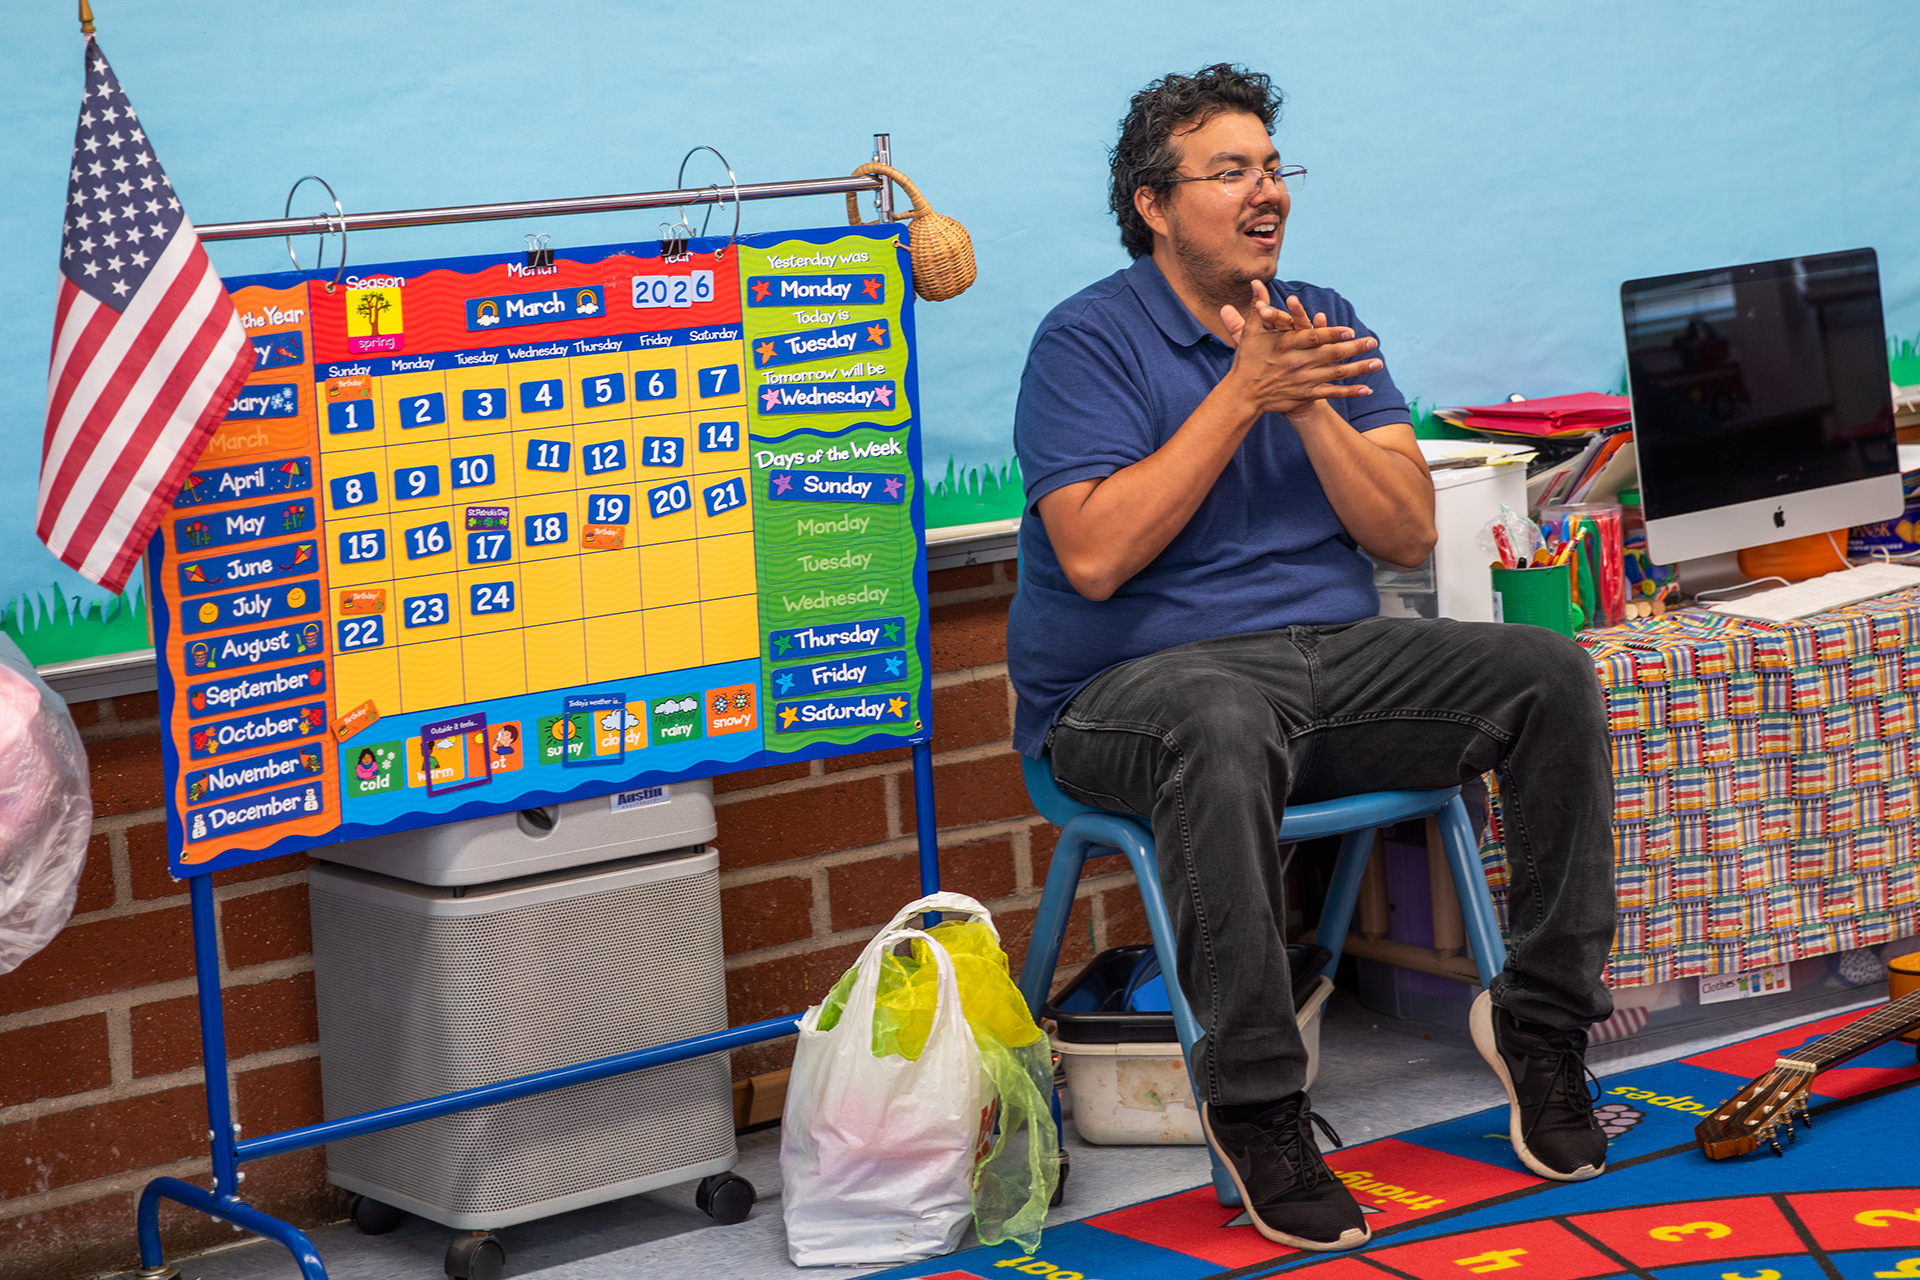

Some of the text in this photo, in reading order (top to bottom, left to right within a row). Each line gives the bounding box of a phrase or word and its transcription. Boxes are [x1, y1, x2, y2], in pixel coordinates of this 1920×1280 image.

[767, 252, 869, 269] Yesterday was
[346, 275, 406, 290] Season
[635, 275, 709, 303] 2026
[781, 278, 852, 300] Monday
[241, 306, 305, 328] the Year
[506, 292, 566, 318] March
[793, 309, 850, 325] Today is
[358, 336, 396, 351] spring
[573, 339, 623, 354] Thursday
[640, 333, 673, 347] Friday
[689, 328, 738, 342] Saturday
[785, 330, 857, 355] Tuesday
[455, 352, 499, 365] Tuesday
[507, 344, 568, 360] Wednesday
[329, 363, 371, 377] Sunday
[391, 357, 435, 372] Monday
[762, 362, 886, 385] Tomorrow will be
[595, 378, 612, 403] 5
[648, 374, 664, 397] 6
[710, 369, 728, 393] 7
[477, 392, 493, 417] 3
[535, 383, 552, 407] 4
[780, 385, 875, 407] Wednesday
[344, 404, 358, 429] 1
[414, 398, 431, 424] 2
[209, 425, 268, 452] March
[706, 424, 734, 449] 14
[536, 443, 560, 468] 11
[590, 444, 620, 470] 12
[650, 440, 677, 464] 13
[755, 437, 903, 470] Days of the Week
[219, 467, 264, 497] April
[408, 470, 426, 496] 9
[458, 458, 488, 485] 10
[345, 479, 363, 504] 8
[710, 483, 740, 512] 21
[803, 476, 872, 499] Sunday
[595, 498, 623, 522] 19
[653, 491, 687, 514] 20
[226, 515, 265, 536] May
[533, 517, 561, 542] 18
[797, 514, 870, 536] Monday
[348, 534, 379, 560] 15
[413, 526, 444, 555] 16
[475, 534, 505, 560] 17
[227, 559, 273, 579] June
[797, 550, 872, 573] Tuesday
[232, 594, 272, 618] July
[476, 585, 510, 611] 24
[783, 585, 889, 612] Wednesday
[411, 598, 444, 624] 23
[343, 620, 379, 647] 22
[794, 624, 880, 649] Thursday
[221, 630, 290, 662] August
[811, 663, 867, 685] Friday
[206, 673, 308, 707] September
[713, 713, 752, 729] snowy
[801, 699, 886, 722] Saturday
[218, 717, 299, 745] October
[601, 729, 641, 748] clody
[661, 724, 693, 738] rainy
[490, 755, 506, 769] ot
[209, 759, 299, 791] November
[360, 774, 390, 791] cold
[618, 787, 662, 805] Austin
[208, 796, 301, 829] December
[1702, 980, 1735, 994] Clothes
[1606, 1086, 1718, 1116] rapes
[1649, 1221, 1732, 1241] 3
[993, 1255, 1104, 1280] oat
[1452, 1248, 1528, 1274] 4
